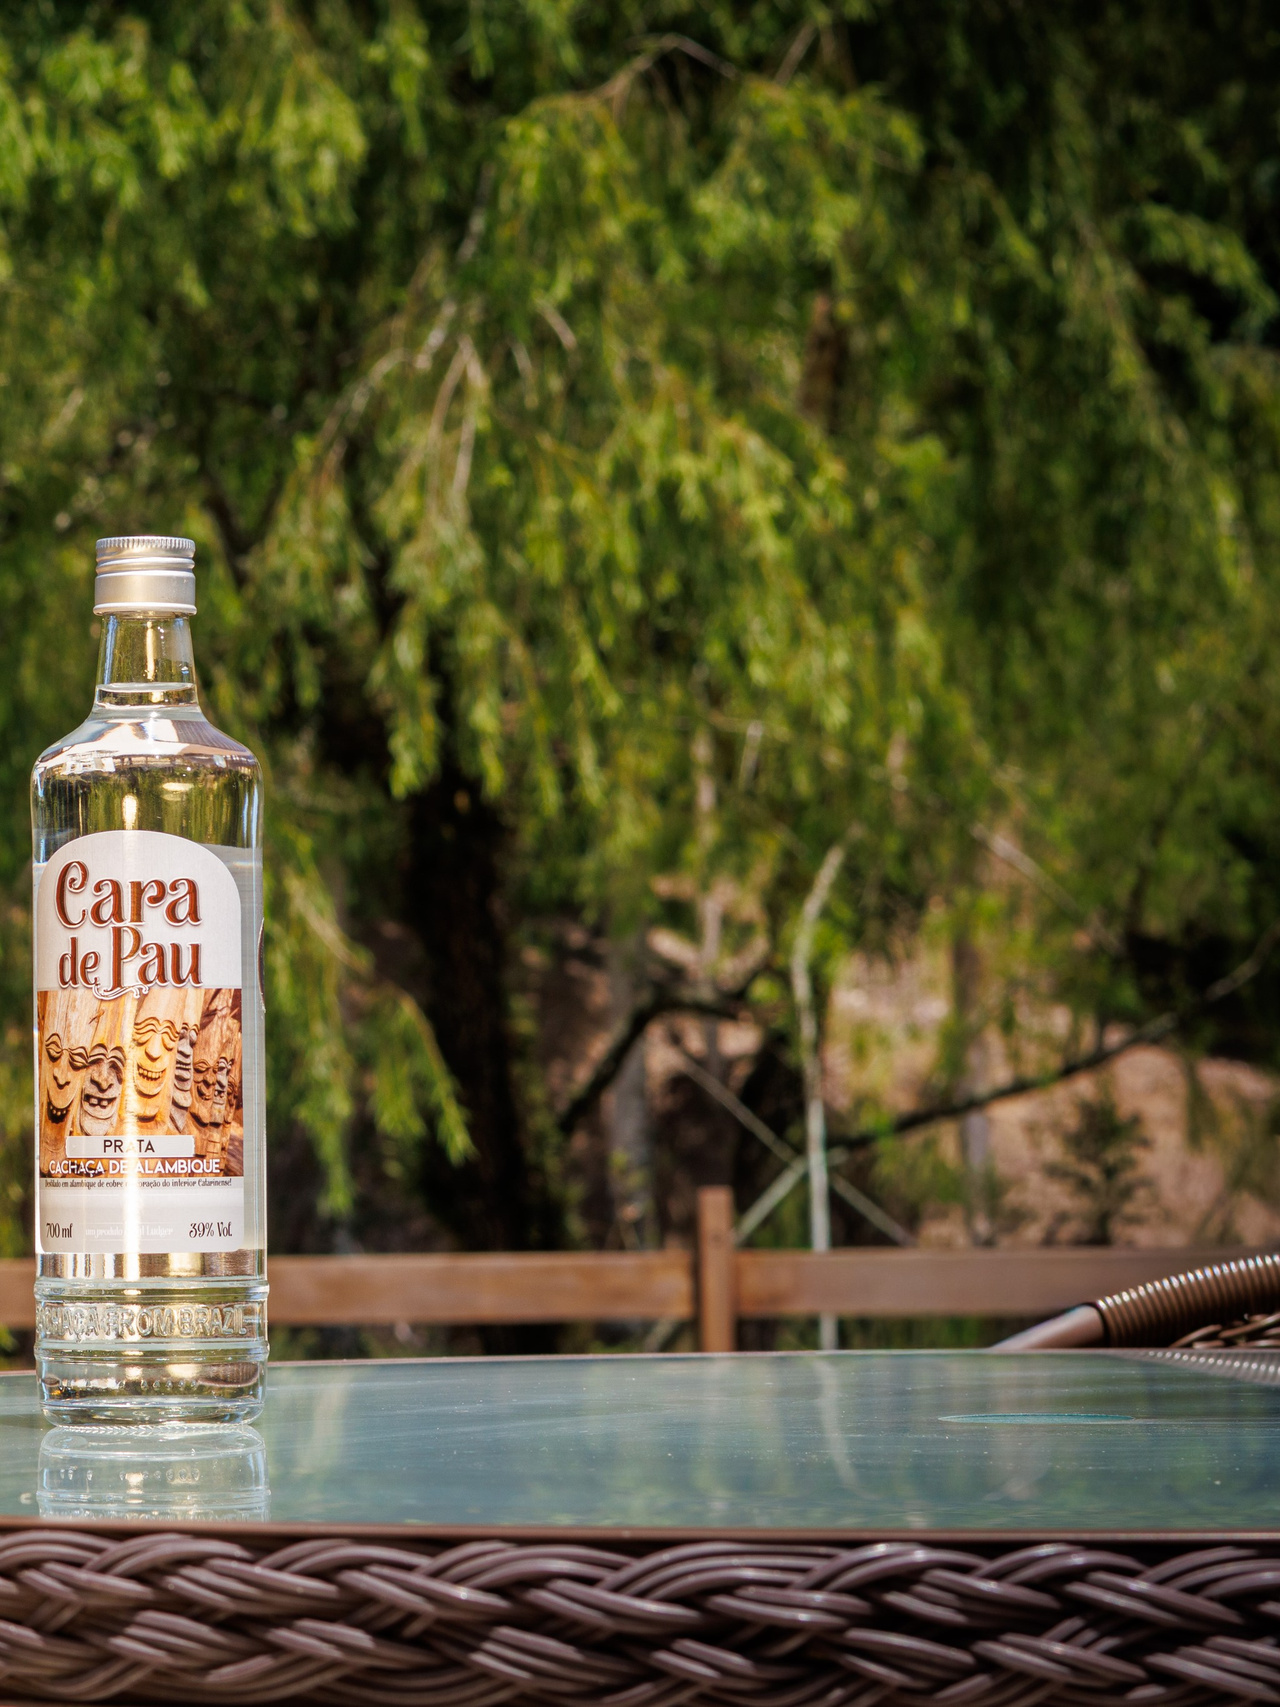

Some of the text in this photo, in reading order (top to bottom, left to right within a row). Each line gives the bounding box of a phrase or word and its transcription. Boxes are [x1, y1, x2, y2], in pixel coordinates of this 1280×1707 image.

[55, 860, 202, 928] Cara
[58, 925, 203, 1000] de Pau
[48, 1158, 220, 1178] CACHAÇA DE ALAMBIQUE
[97, 1179, 105, 1188] de
[135, 1179, 161, 1189] oração
[161, 1179, 170, 1188] do
[171, 1178, 197, 1187] interior
[45, 1222, 73, 1239] 700 ml
[188, 1222, 214, 1238] 39%
[179, 1305, 247, 1337] BRAZIL
